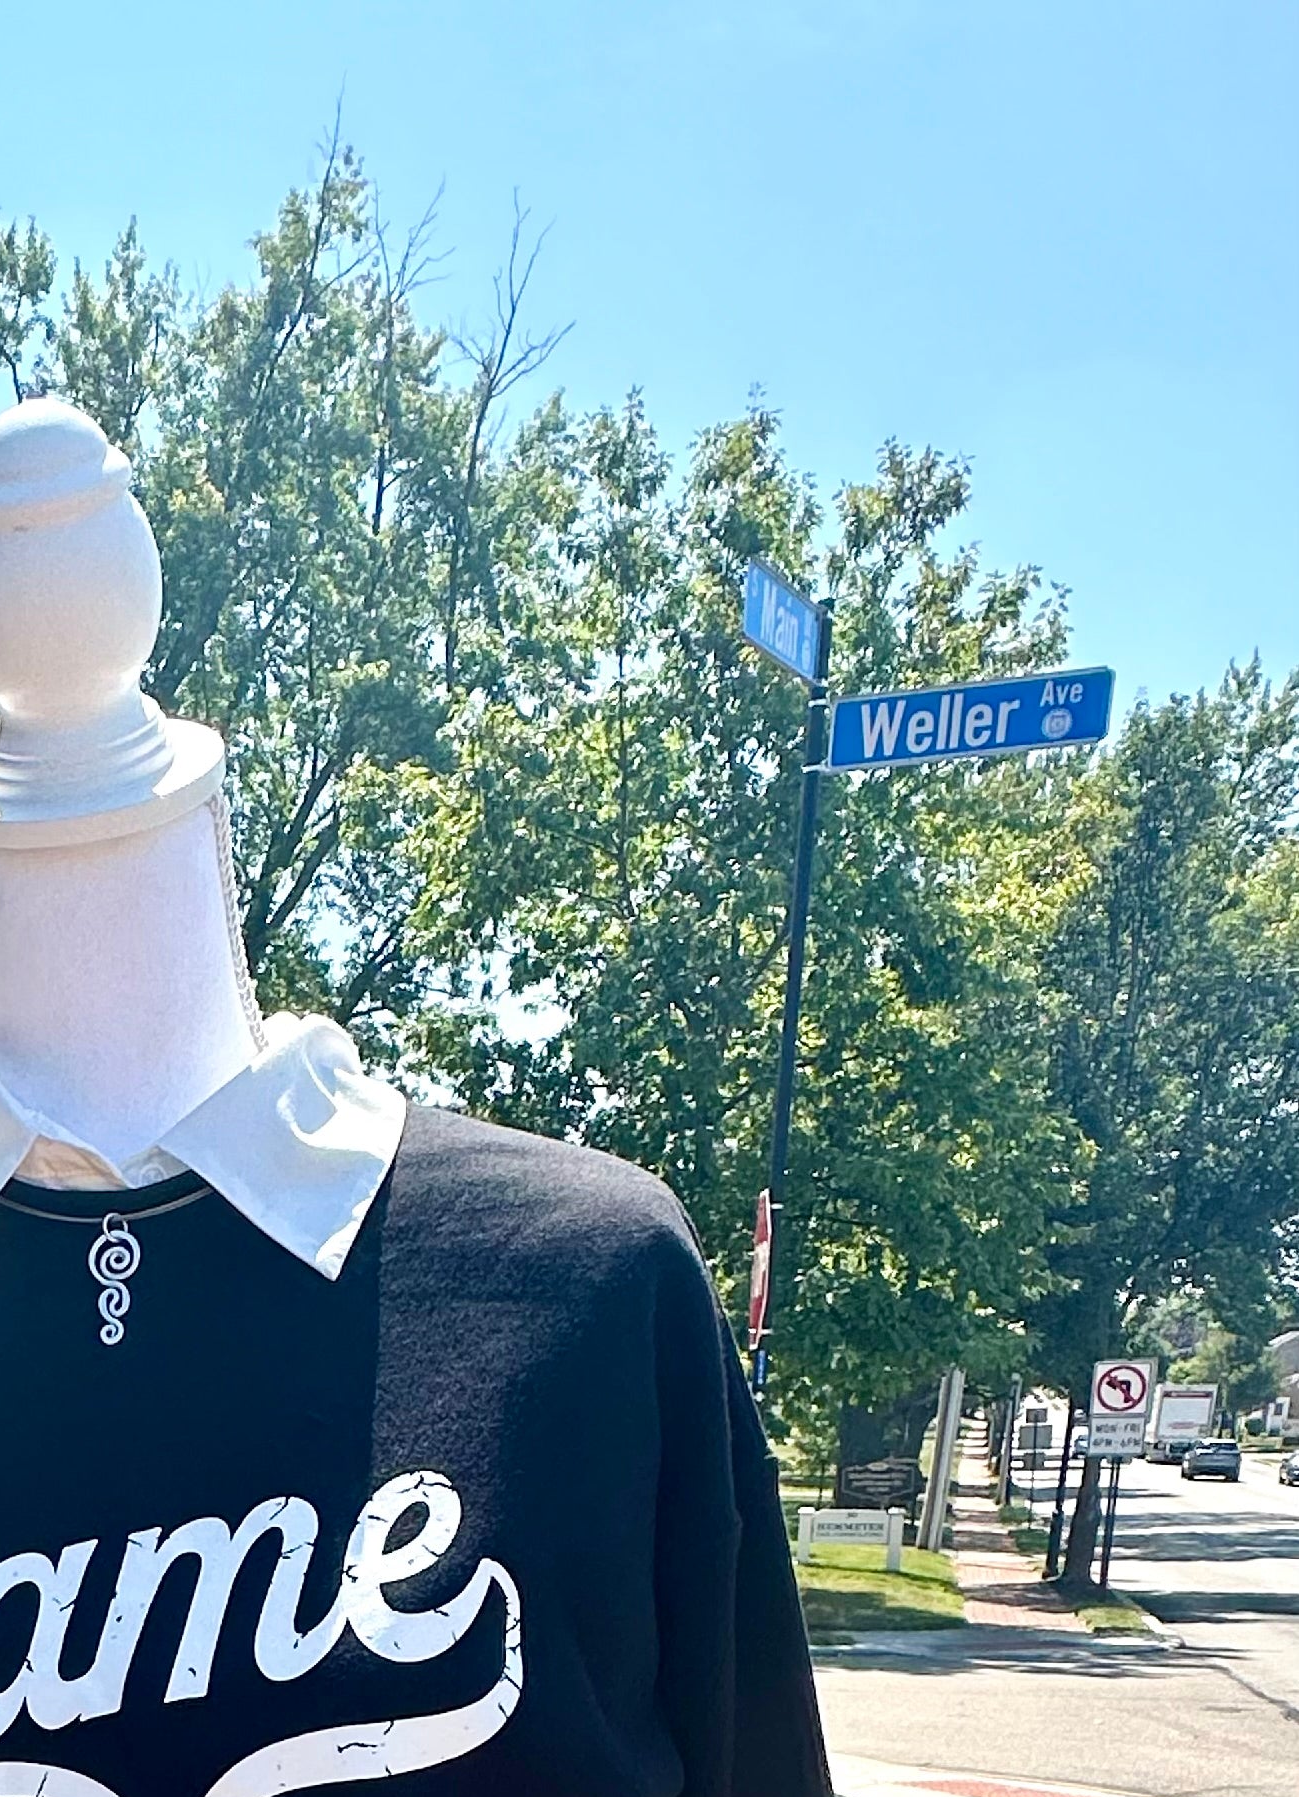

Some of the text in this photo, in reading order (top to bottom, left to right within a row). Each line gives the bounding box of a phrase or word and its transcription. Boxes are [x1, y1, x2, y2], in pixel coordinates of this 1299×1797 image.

[761, 579, 799, 662] Main
[861, 679, 1084, 758] Weller Ave
